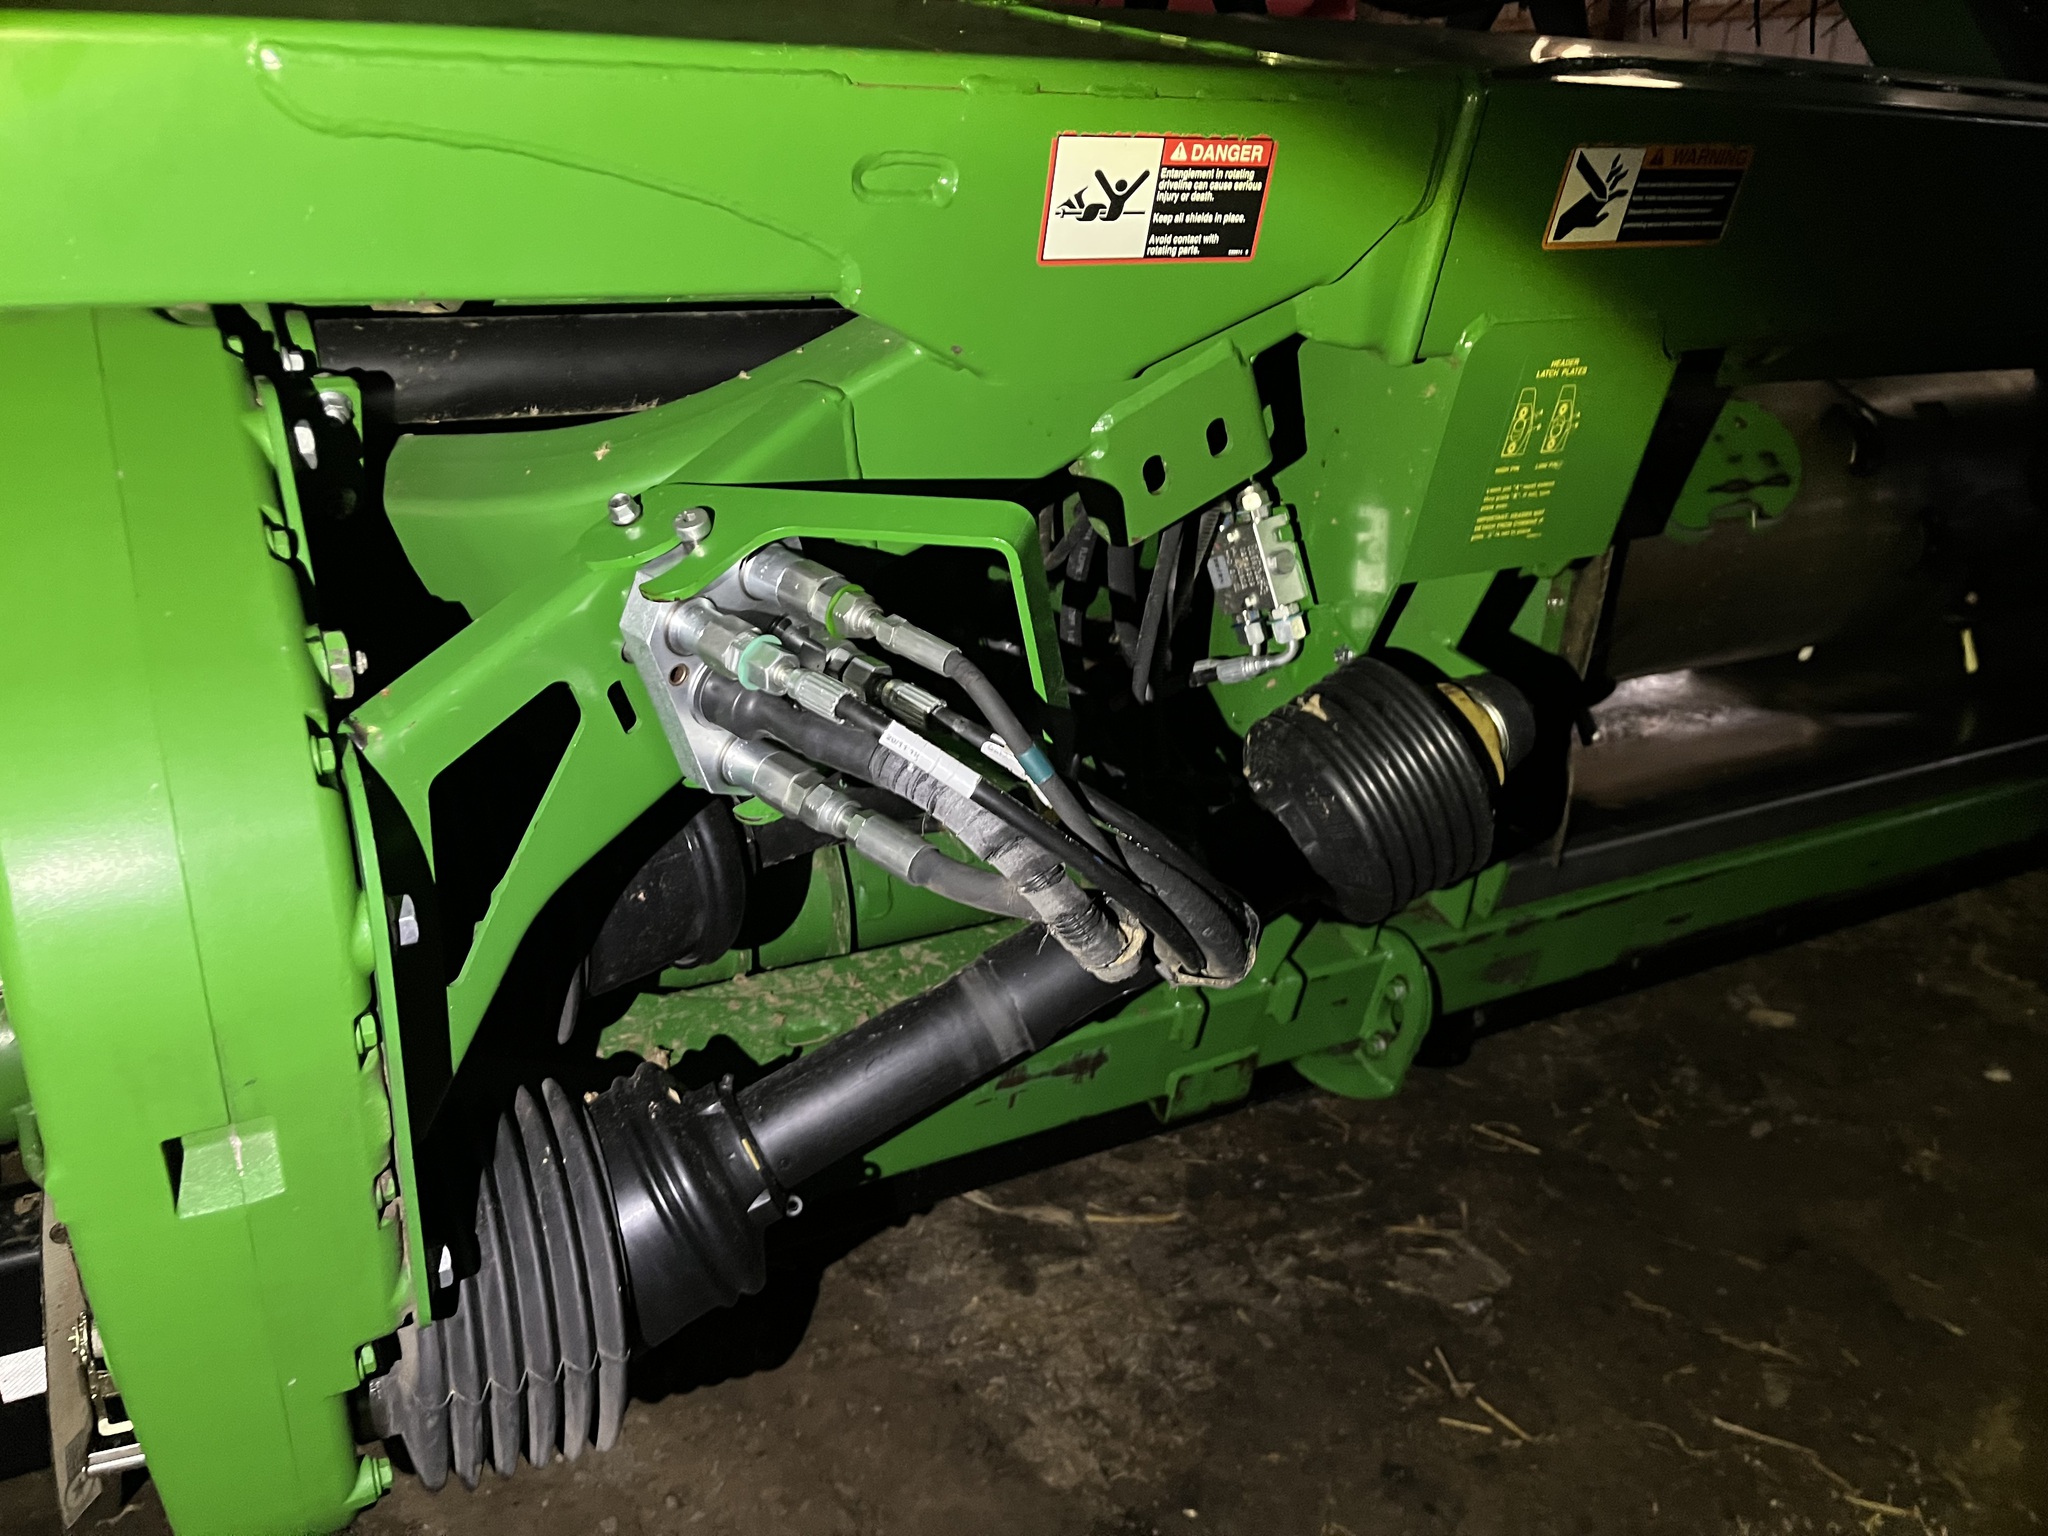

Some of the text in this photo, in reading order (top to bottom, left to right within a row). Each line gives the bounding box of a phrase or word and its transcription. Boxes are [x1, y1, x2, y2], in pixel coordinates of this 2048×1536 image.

[1191, 143, 1264, 162] DANGER
[1672, 148, 1748, 167] WARNING
[1160, 167, 1255, 181] Entanglement in rotating
[1158, 179, 1263, 191] driveline can cause serious
[1156, 191, 1215, 204] injury or death.
[1153, 212, 1246, 226] Keep all shields in place.
[1148, 233, 1220, 245] Avoid contact with
[1146, 245, 1200, 258] rotating parts.
[1550, 357, 1580, 368] HEADER
[1535, 366, 1588, 380] LATCH PLATES
